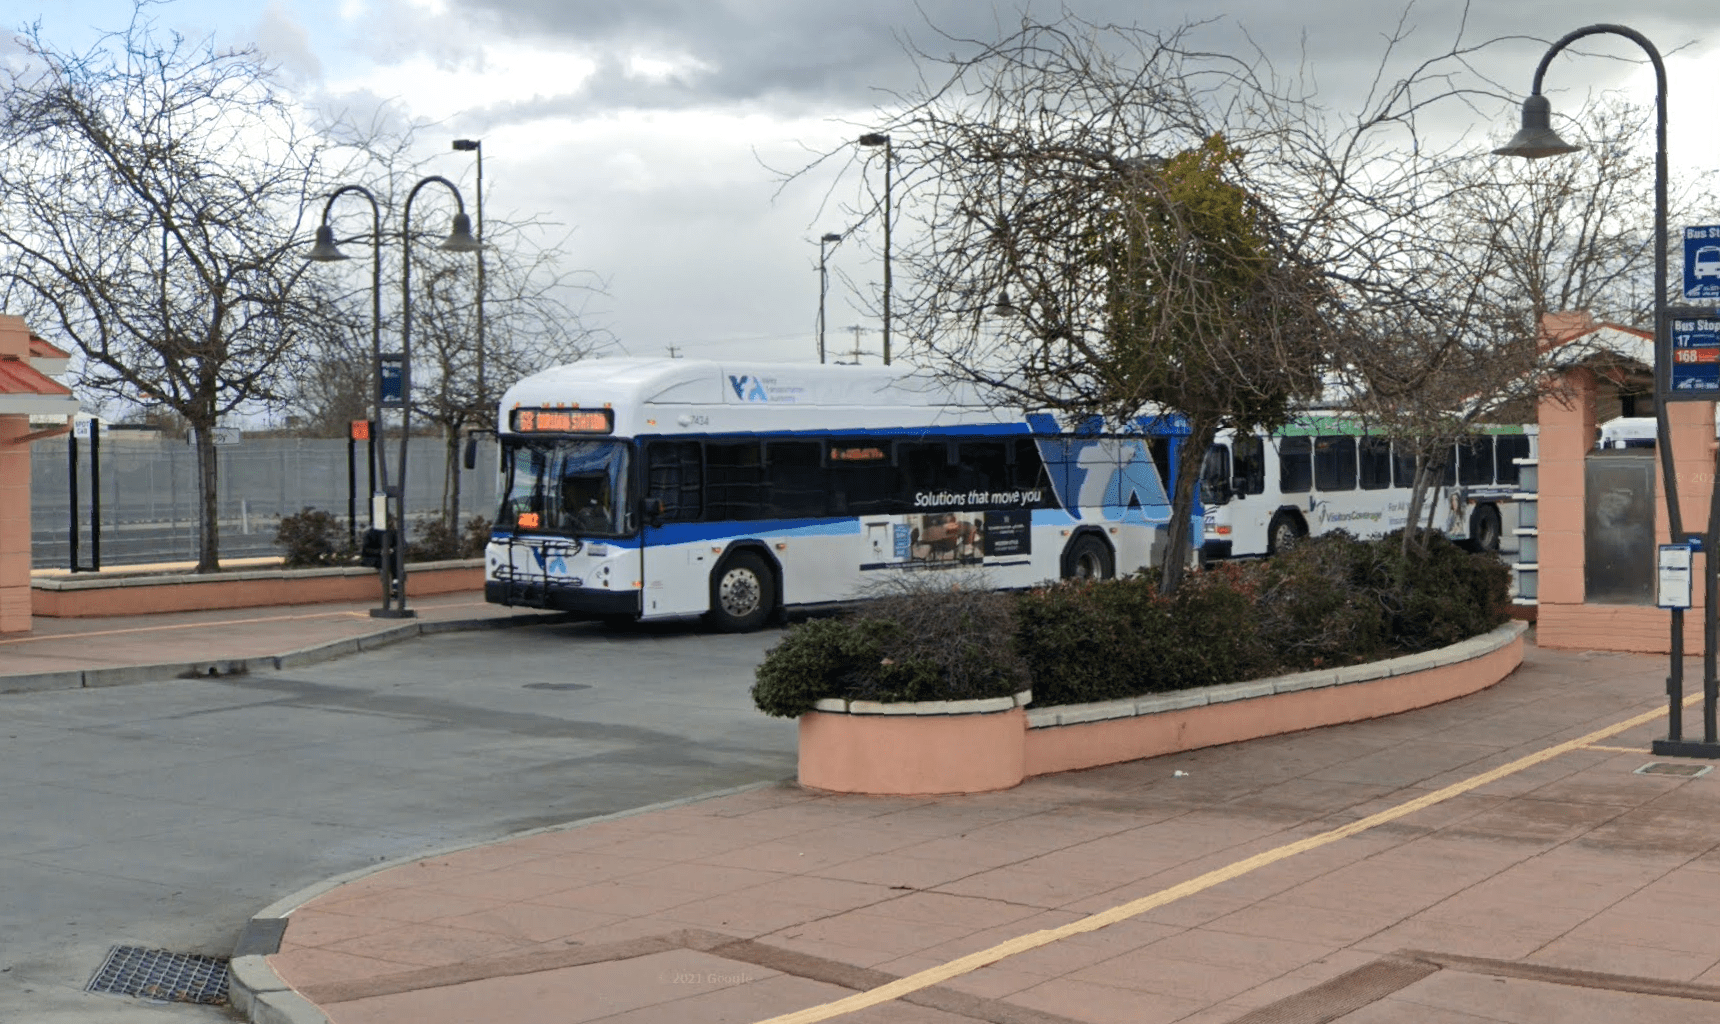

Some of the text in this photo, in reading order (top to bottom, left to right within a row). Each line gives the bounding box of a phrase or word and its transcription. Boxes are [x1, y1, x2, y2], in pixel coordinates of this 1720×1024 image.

[1687, 227, 1720, 239] Bus St
[1675, 320, 1720, 333] Bus Stop
[1676, 334, 1690, 347] 17
[1677, 349, 1698, 363] 168
[690, 415, 709, 426] 7434
[914, 489, 1042, 507] Solutions that move you
